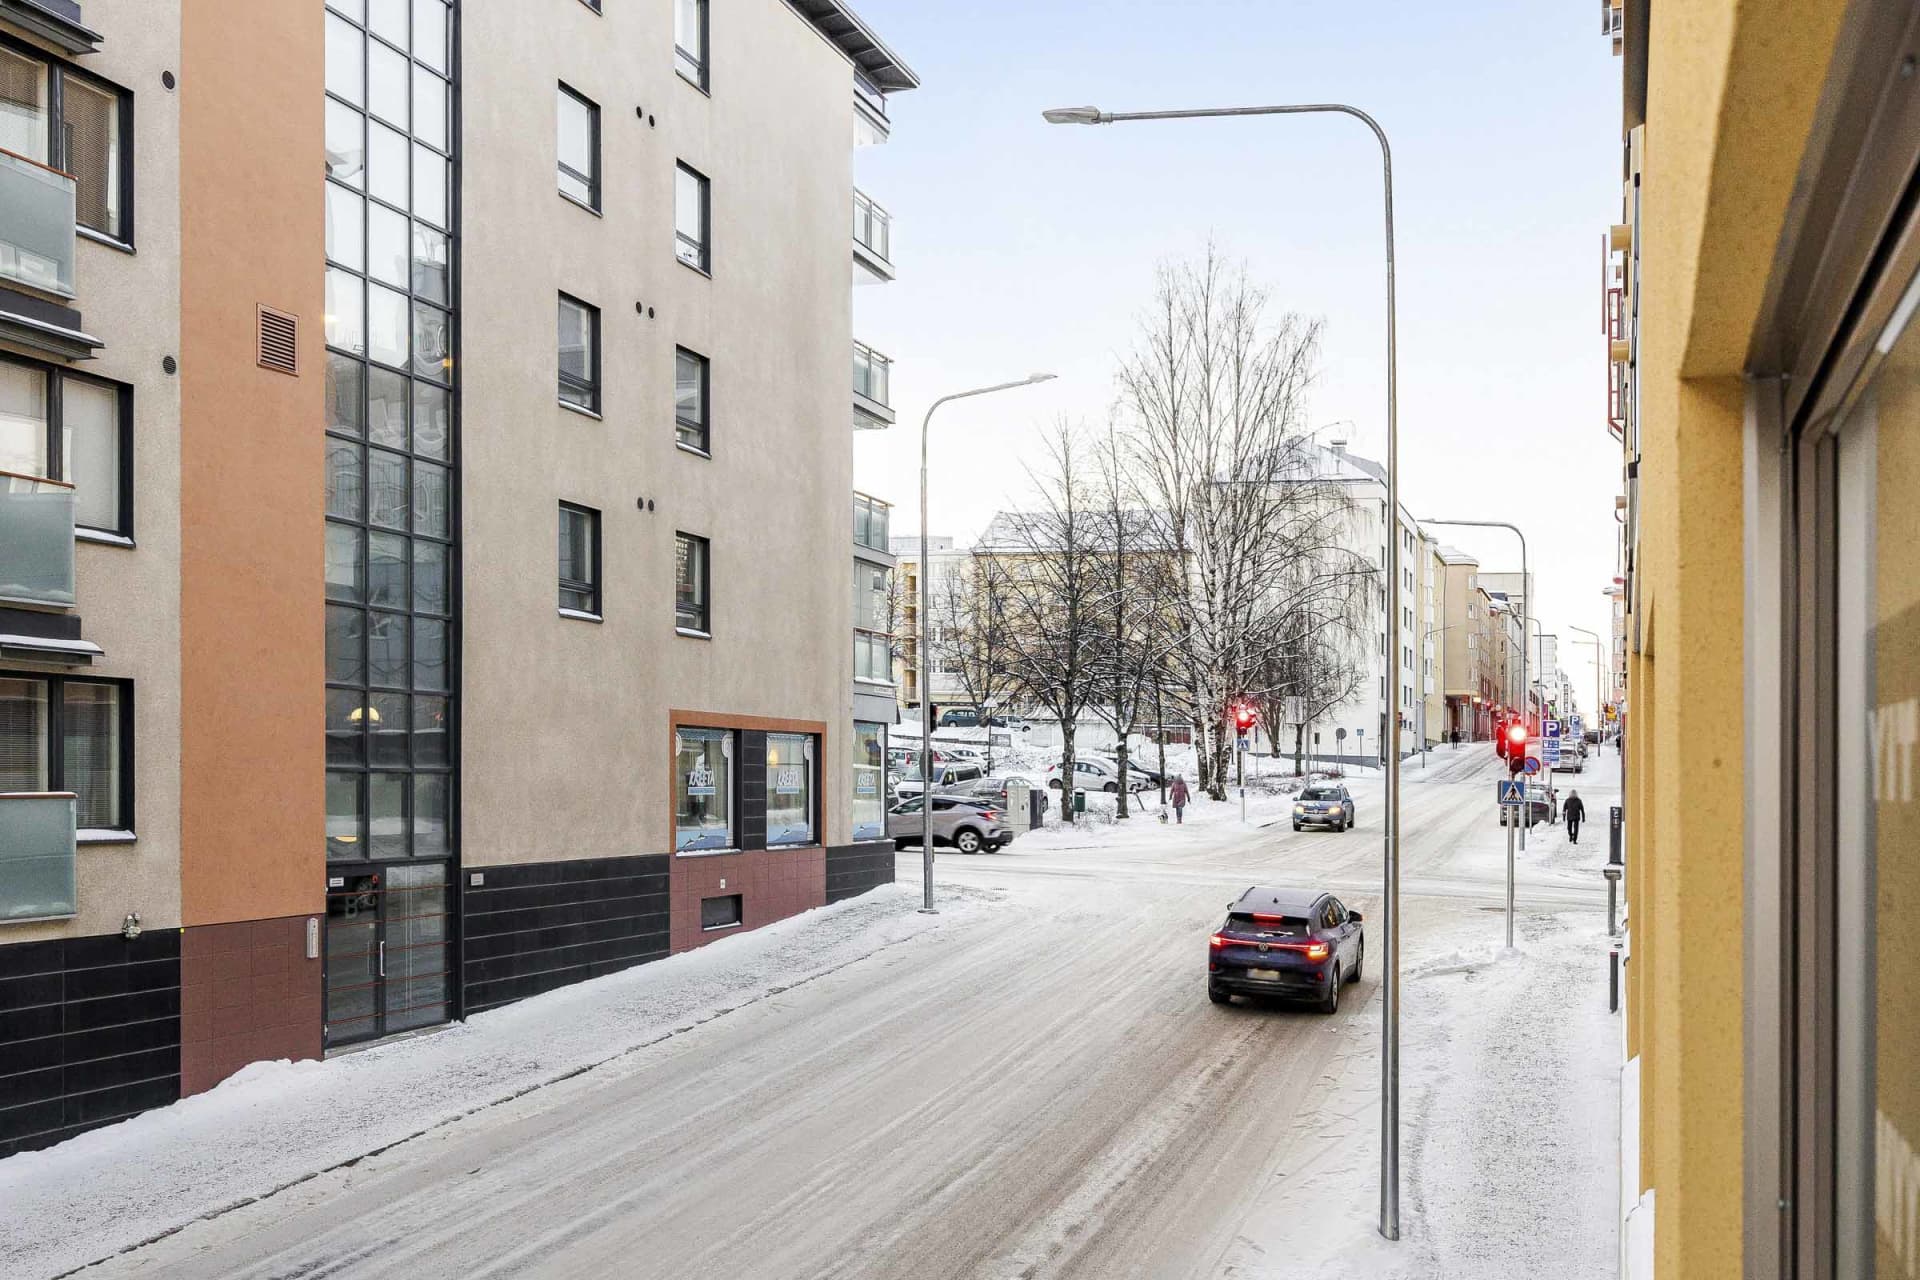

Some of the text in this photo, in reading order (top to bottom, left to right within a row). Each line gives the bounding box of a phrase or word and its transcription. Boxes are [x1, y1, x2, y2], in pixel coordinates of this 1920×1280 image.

[1571, 716, 1578, 724] P
[1546, 722, 1558, 737] P
[689, 769, 715, 786] KREETA
